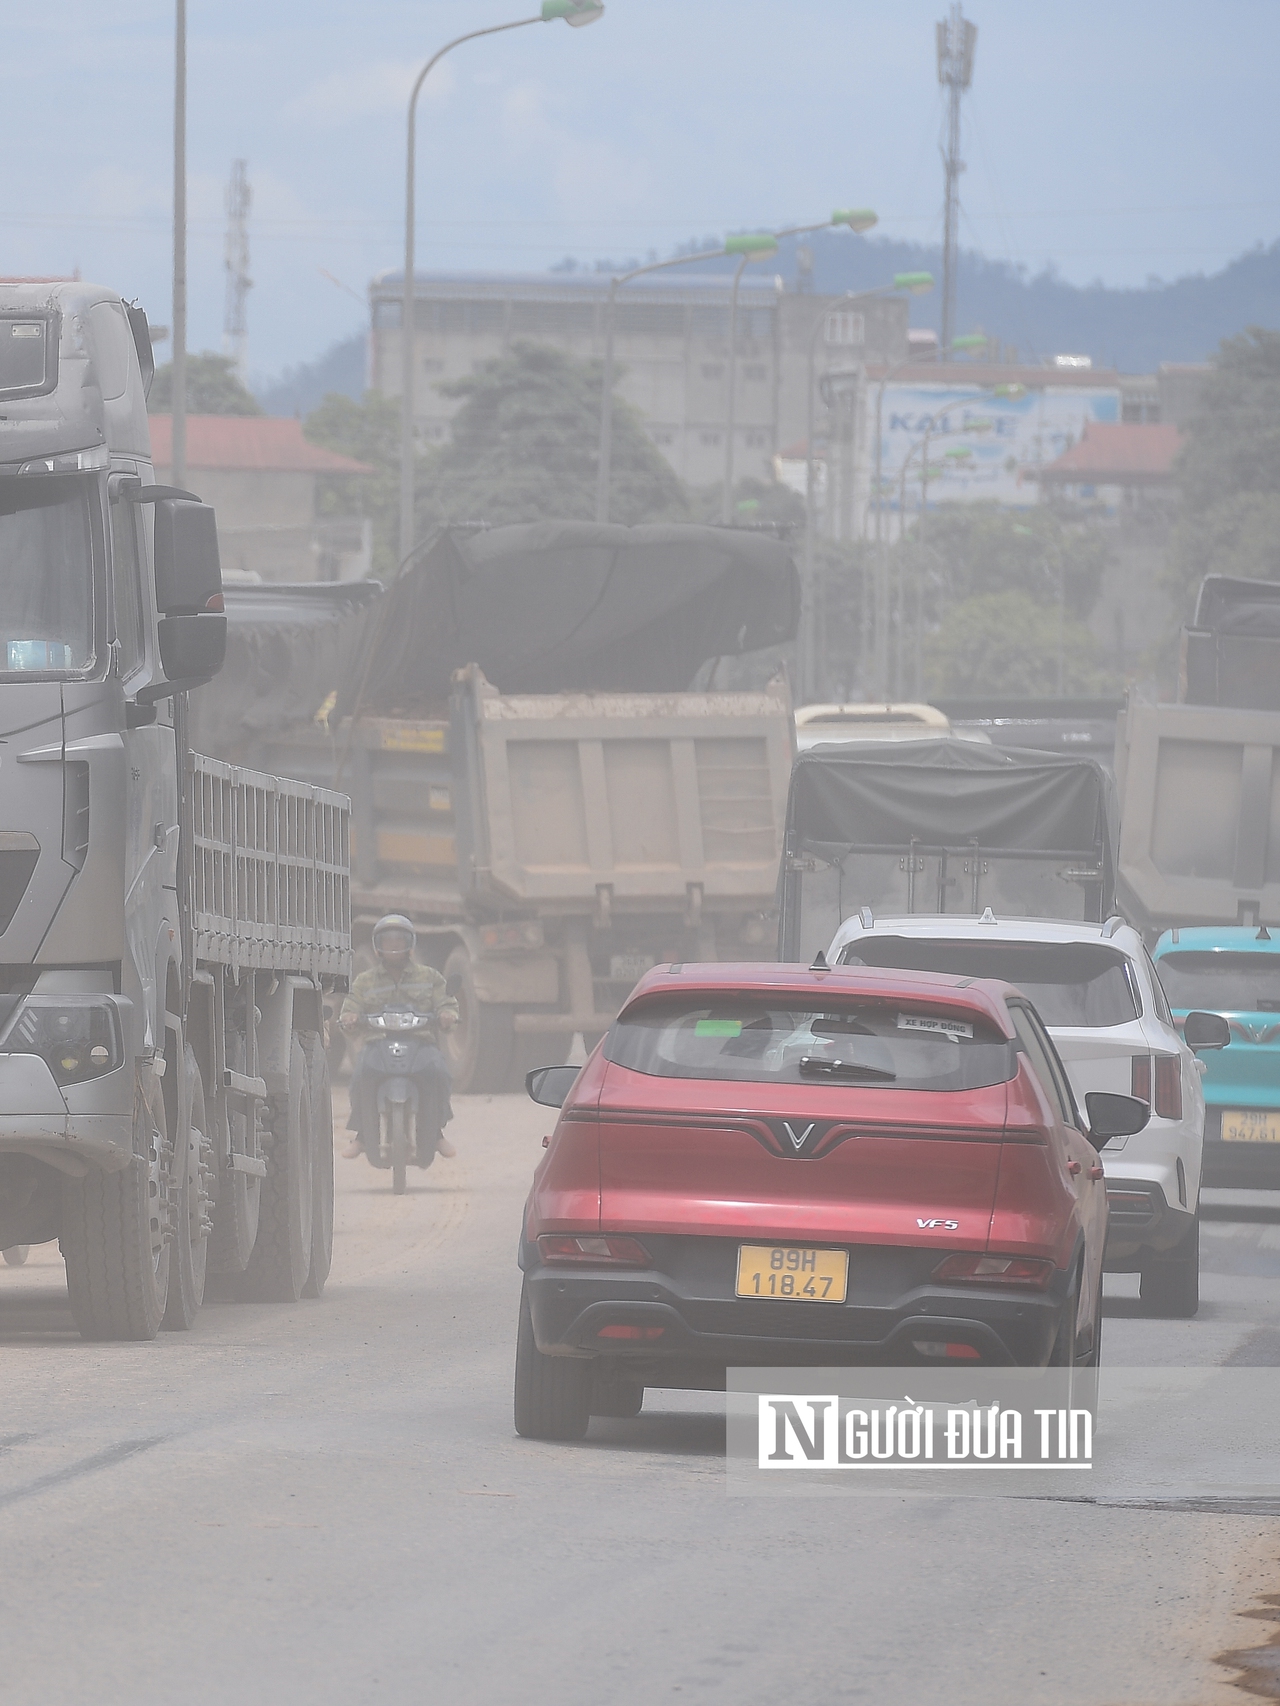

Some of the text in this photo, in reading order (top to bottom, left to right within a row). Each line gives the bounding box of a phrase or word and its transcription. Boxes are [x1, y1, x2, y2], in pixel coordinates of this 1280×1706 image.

[906, 1019, 917, 1027] XE
[1240, 1112, 1267, 1125] 29H
[916, 1218, 959, 1231] VF5
[770, 1248, 817, 1273] 89H
[752, 1272, 833, 1298] 118.47
